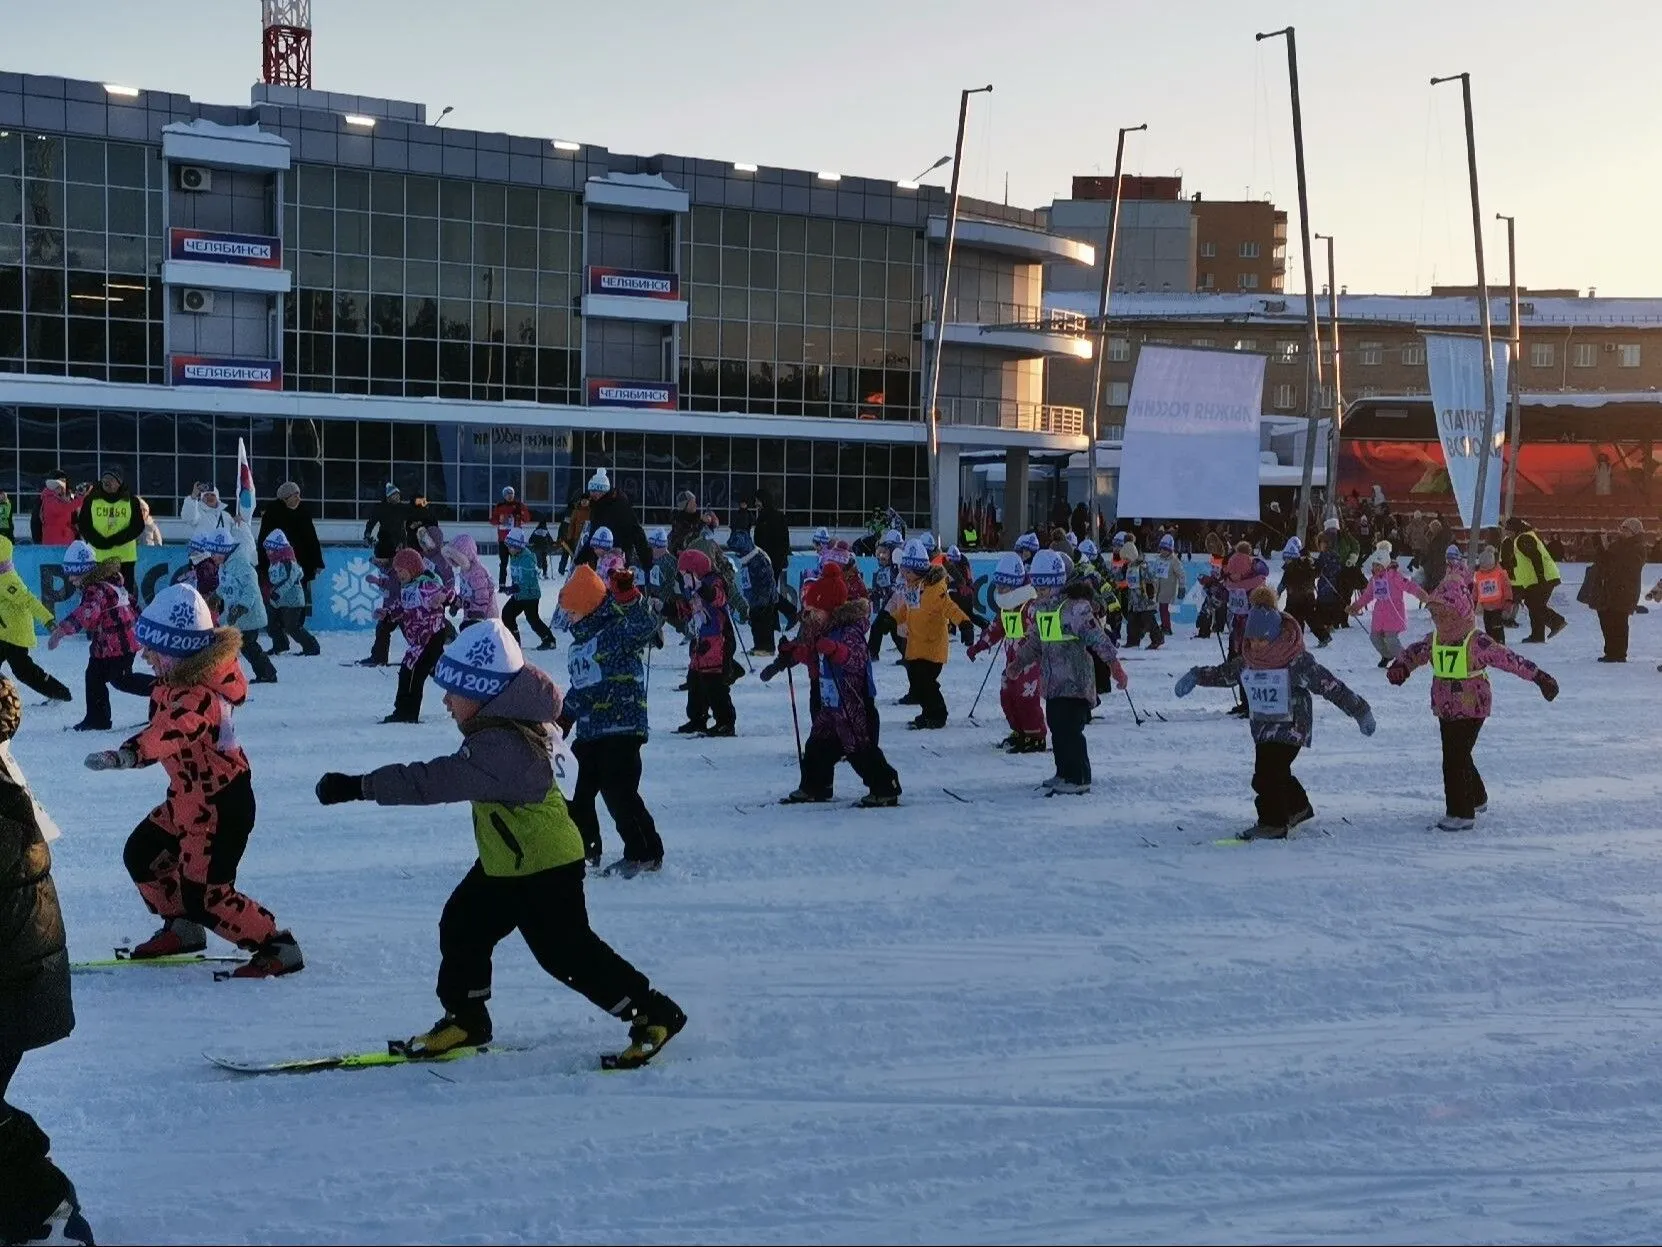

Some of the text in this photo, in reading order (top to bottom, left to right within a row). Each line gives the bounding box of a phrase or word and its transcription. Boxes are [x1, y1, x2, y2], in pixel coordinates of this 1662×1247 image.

[186, 239, 270, 257] ЧЕЛЯБИНСК
[602, 276, 670, 291] ЧЕЛЯБИНСК
[186, 366, 270, 380] ЧЕЛЯБИНСК
[600, 388, 667, 402] ЧЕЛЯБИНСК
[96, 507, 127, 518] СУДЬЯ
[1005, 615, 1017, 634] 17
[1040, 615, 1053, 638] 17
[1436, 650, 1459, 673] 17
